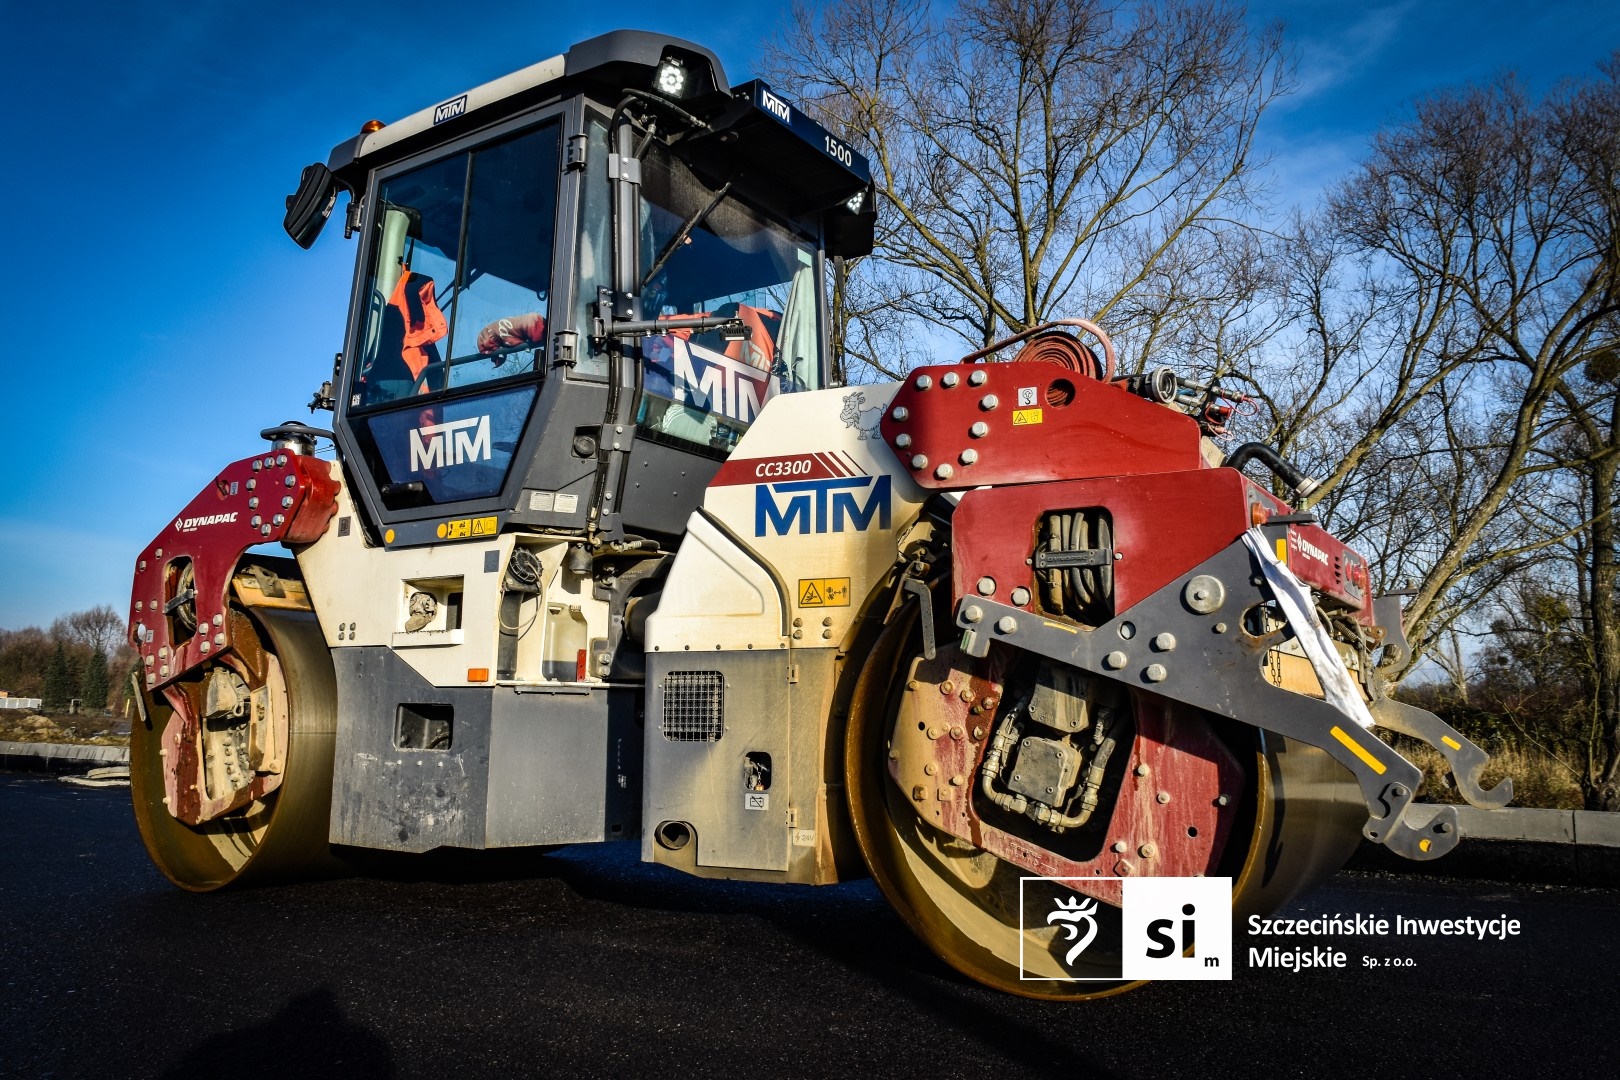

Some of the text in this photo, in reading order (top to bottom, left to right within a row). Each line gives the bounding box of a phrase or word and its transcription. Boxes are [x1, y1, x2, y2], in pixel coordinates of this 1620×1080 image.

[435, 97, 466, 123] MTM
[763, 89, 790, 123] MTM
[824, 135, 852, 167] 1500
[410, 415, 491, 472] MTM
[755, 459, 812, 478] CC3300
[183, 511, 239, 529] DYNAPAC
[755, 475, 892, 537] MTM
[1302, 538, 1329, 566] DYNAPAC
